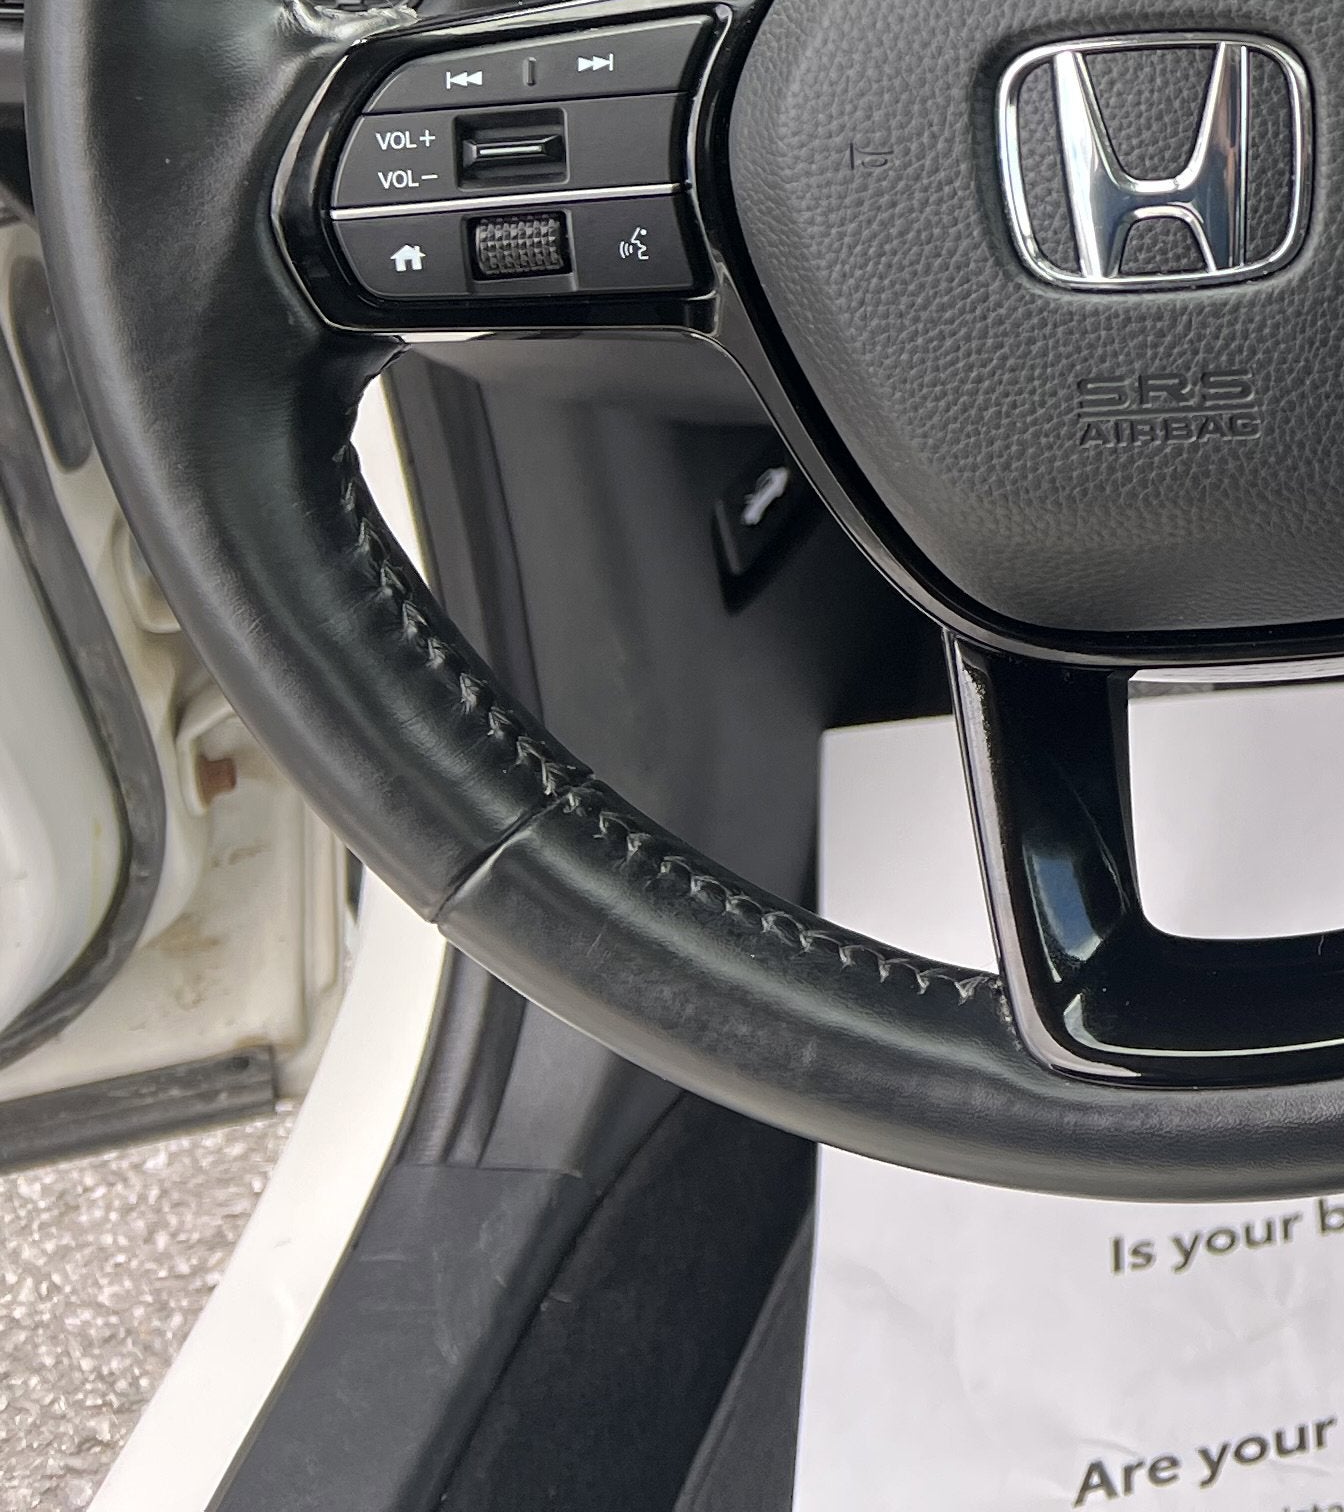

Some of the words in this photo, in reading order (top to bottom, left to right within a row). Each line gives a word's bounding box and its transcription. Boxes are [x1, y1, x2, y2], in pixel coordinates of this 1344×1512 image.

[376, 130, 436, 150] VOL+
[1078, 370, 1255, 410] SRS
[1080, 416, 1261, 447] AIRBAG
[1110, 1235, 1155, 1273] Is
[1172, 1212, 1303, 1272] your
[1073, 1454, 1181, 1508] Are
[1199, 1415, 1335, 1487] your
